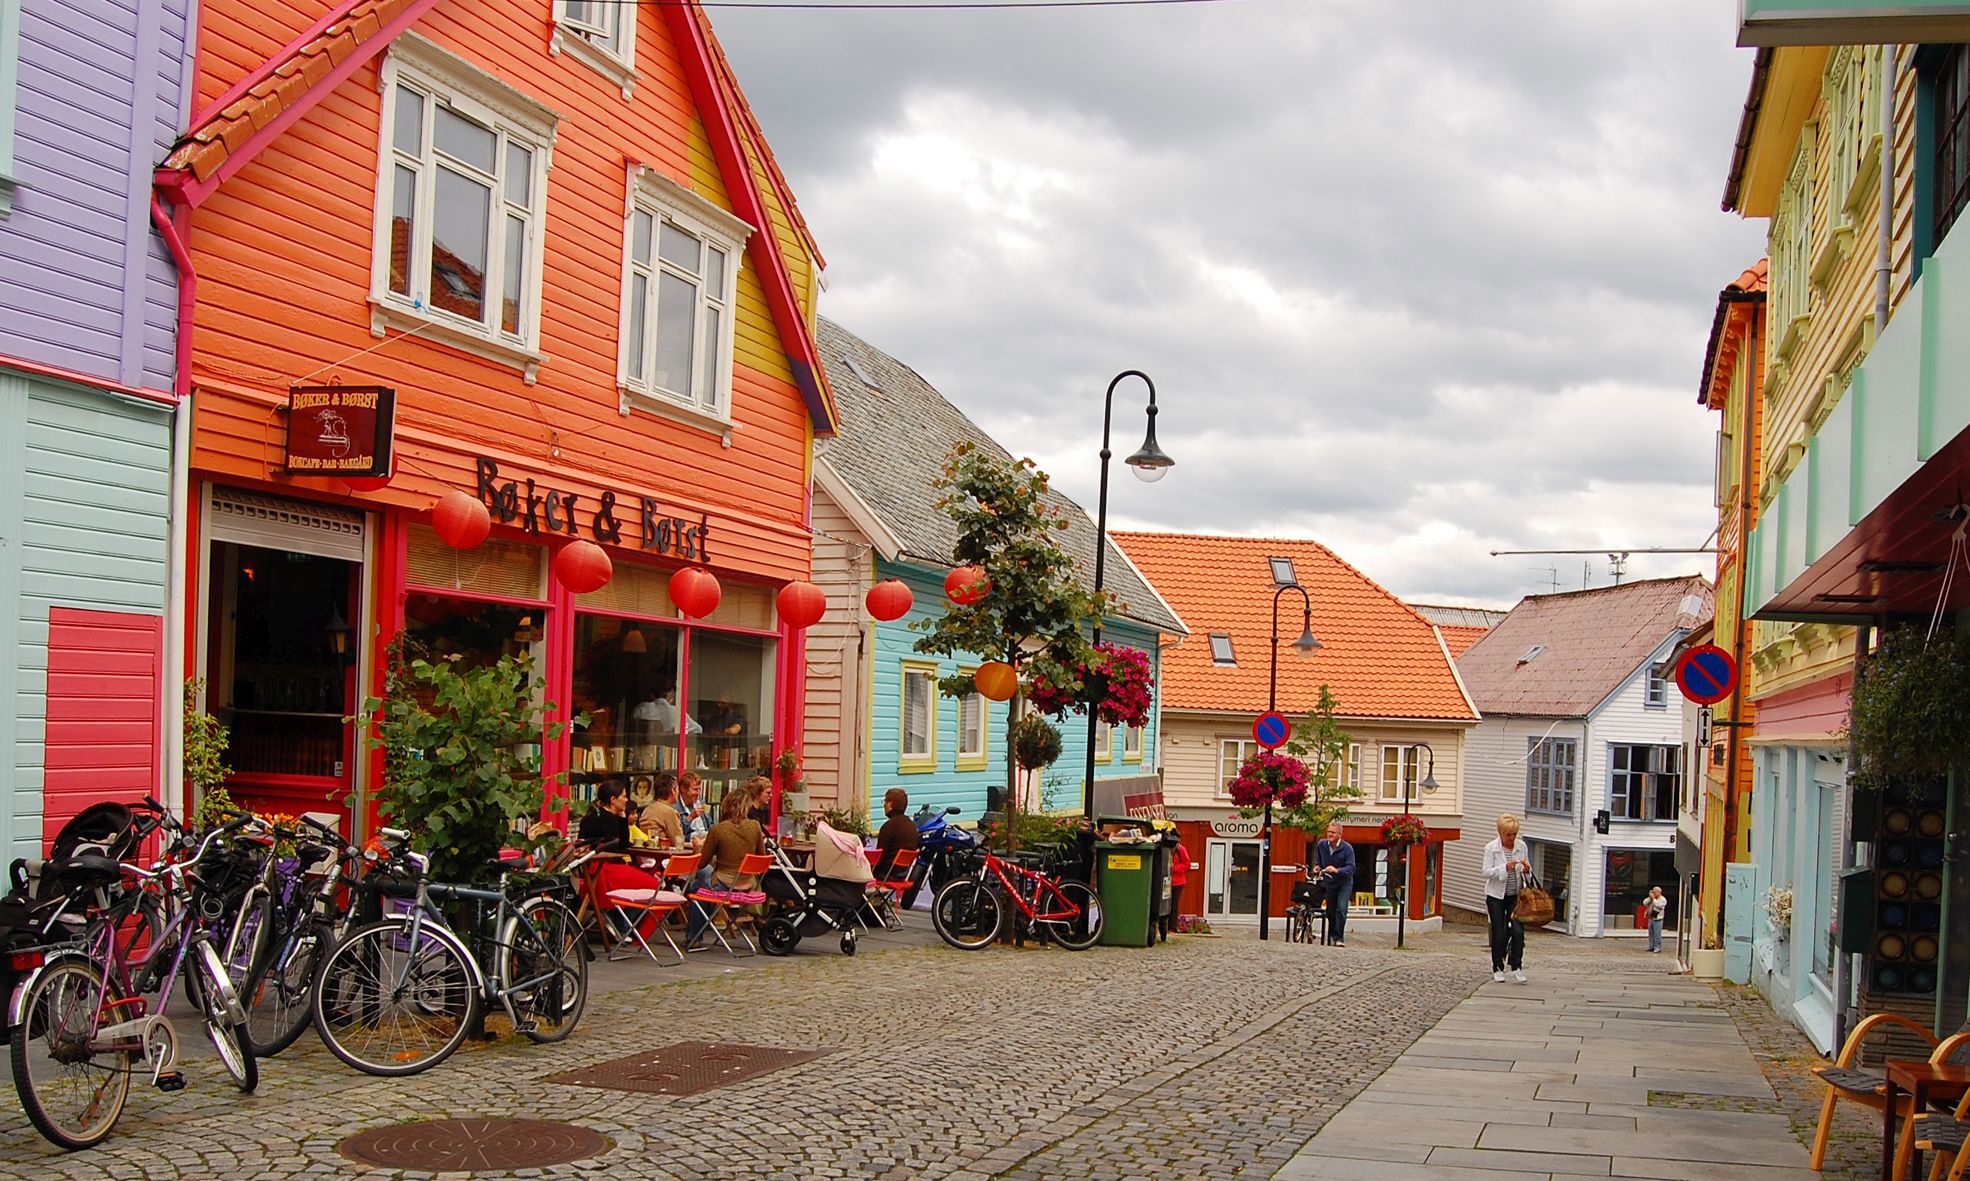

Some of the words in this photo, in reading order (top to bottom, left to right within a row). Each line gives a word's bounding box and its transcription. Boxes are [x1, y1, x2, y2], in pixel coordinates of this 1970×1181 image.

[293, 393, 329, 410] BØKER
[331, 393, 340, 405] &
[341, 393, 378, 409] BØRST
[476, 457, 578, 537] Bøker
[593, 491, 622, 545] &
[641, 495, 711, 563] Børst
[1214, 822, 1259, 833] aroma
